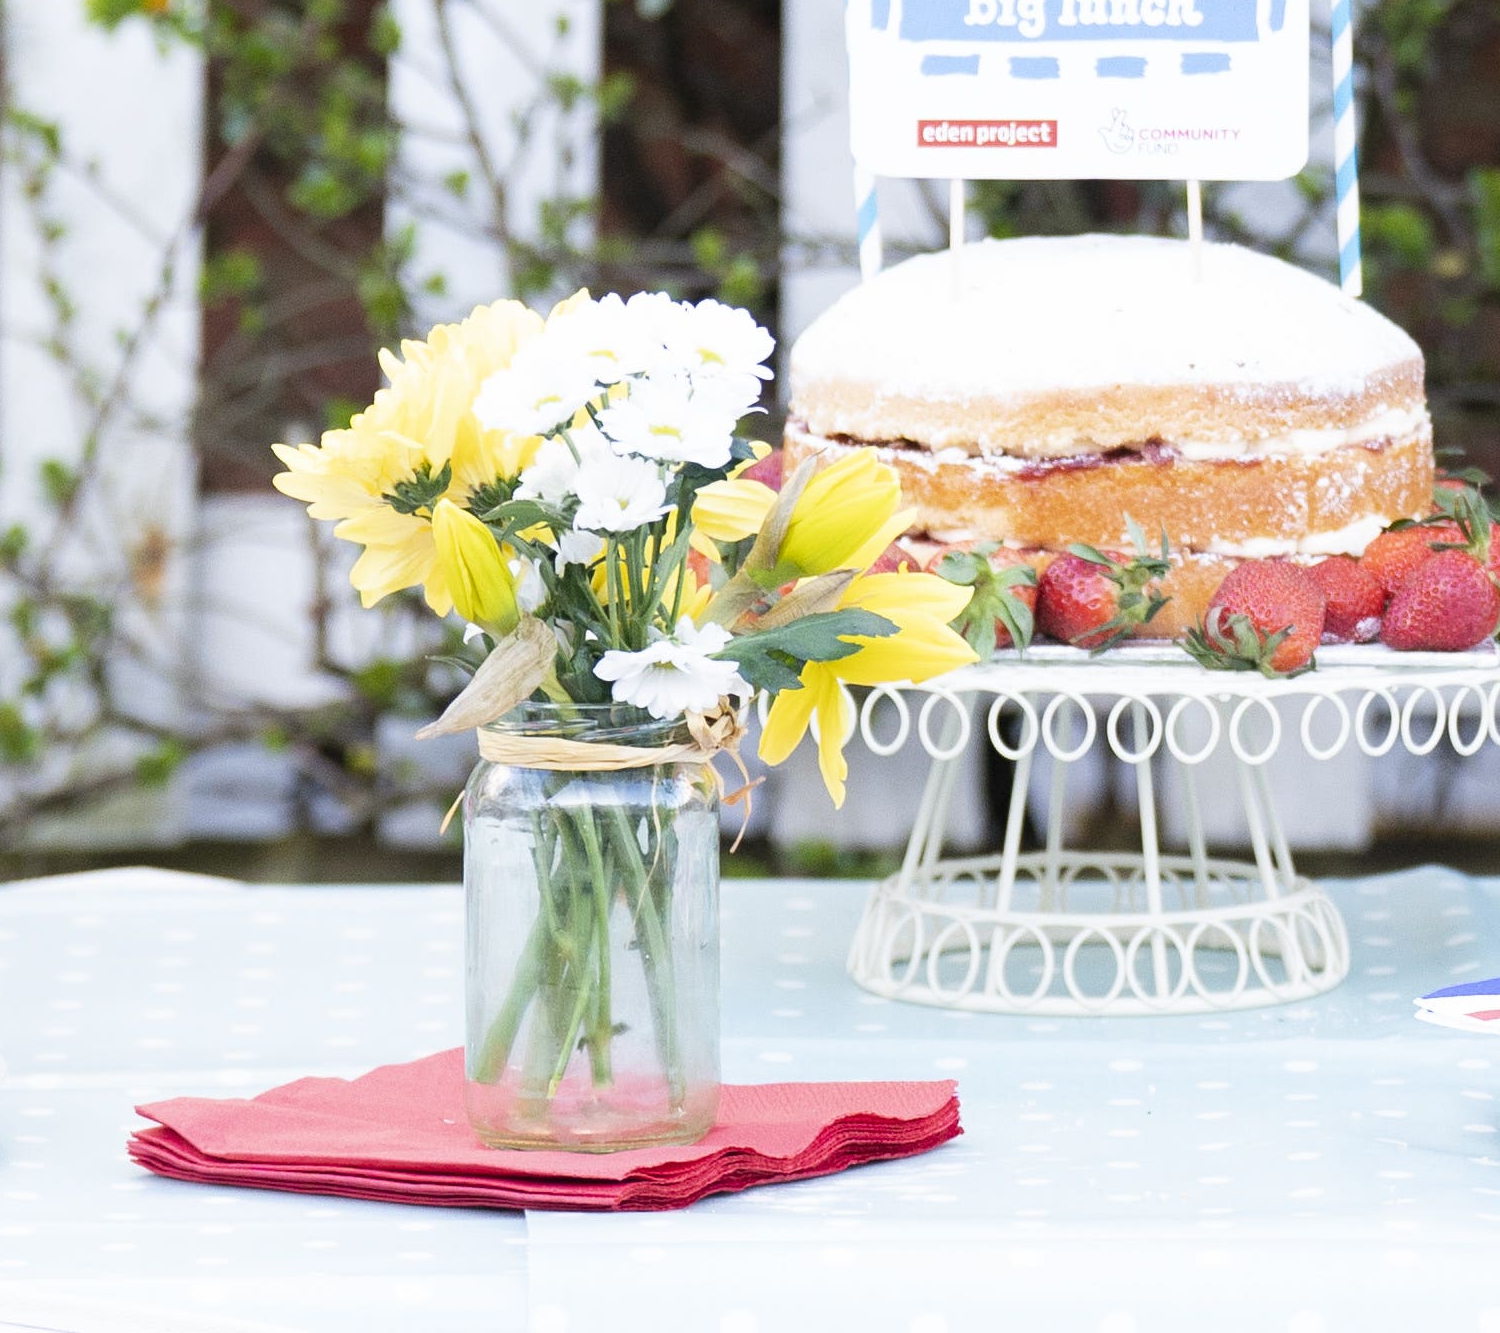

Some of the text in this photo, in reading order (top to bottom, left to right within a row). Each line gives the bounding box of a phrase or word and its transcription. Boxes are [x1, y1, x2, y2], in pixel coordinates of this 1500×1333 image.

[922, 122, 1052, 146] eden project
[1138, 128, 1241, 141] COMMUNITY
[1138, 143, 1178, 155] FUND
